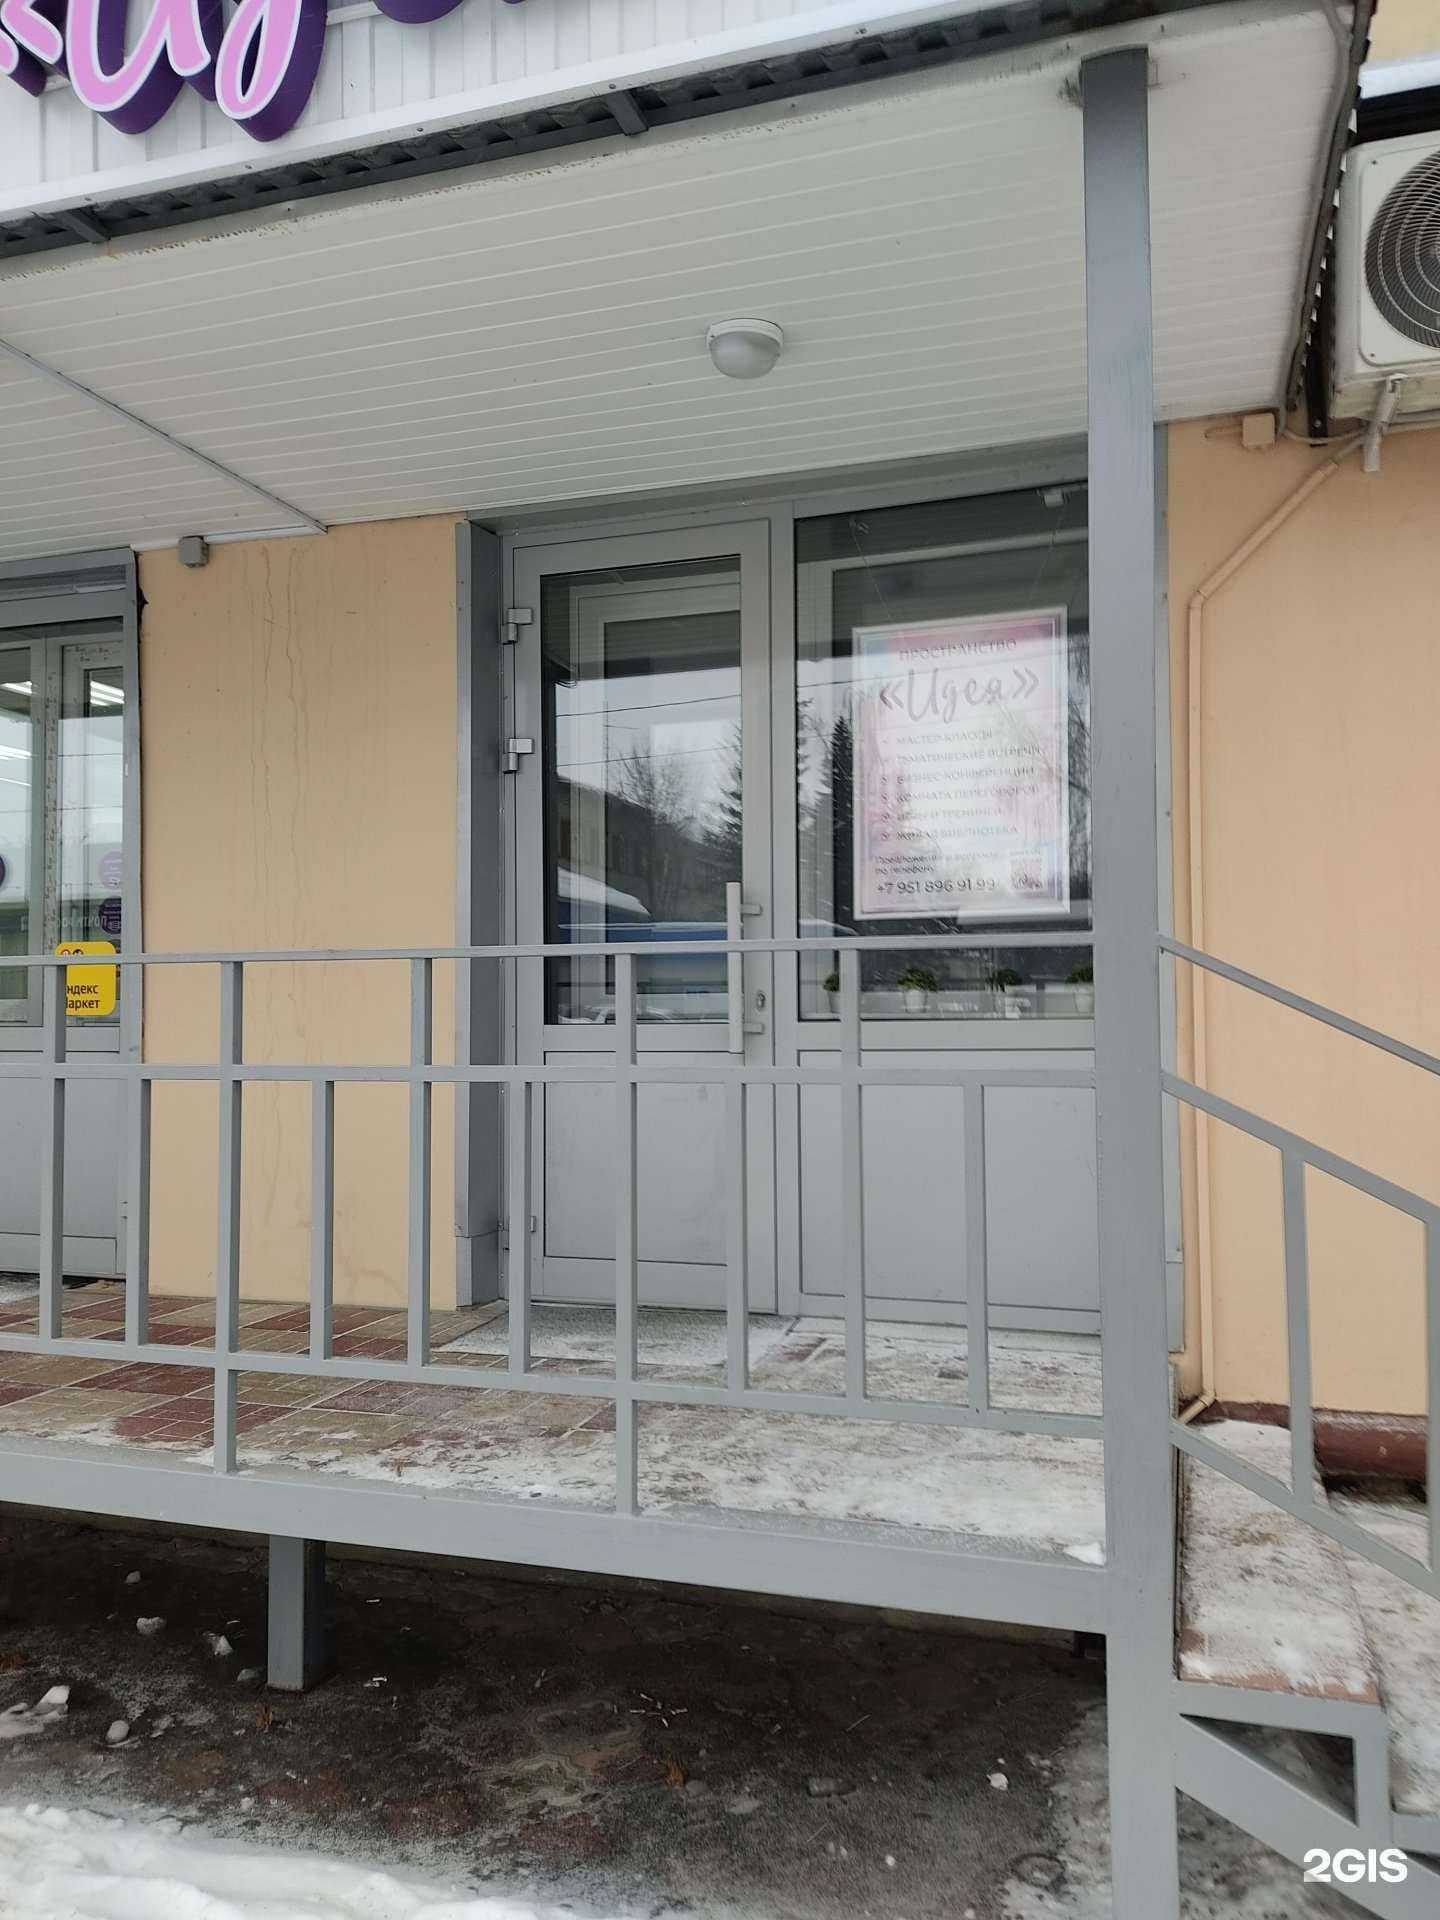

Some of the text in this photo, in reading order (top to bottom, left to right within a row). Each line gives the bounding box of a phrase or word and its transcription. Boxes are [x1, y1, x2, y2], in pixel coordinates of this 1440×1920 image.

[899, 639, 1017, 660] ПРОСТРАНСТВО
[879, 667, 1040, 724] «Идея»
[877, 881, 894, 895] +7
[896, 879, 920, 894] 951
[956, 878, 971, 891] 91
[976, 878, 995, 891] 99
[66, 984, 99, 995] ндекс
[66, 997, 100, 1010] аркет
